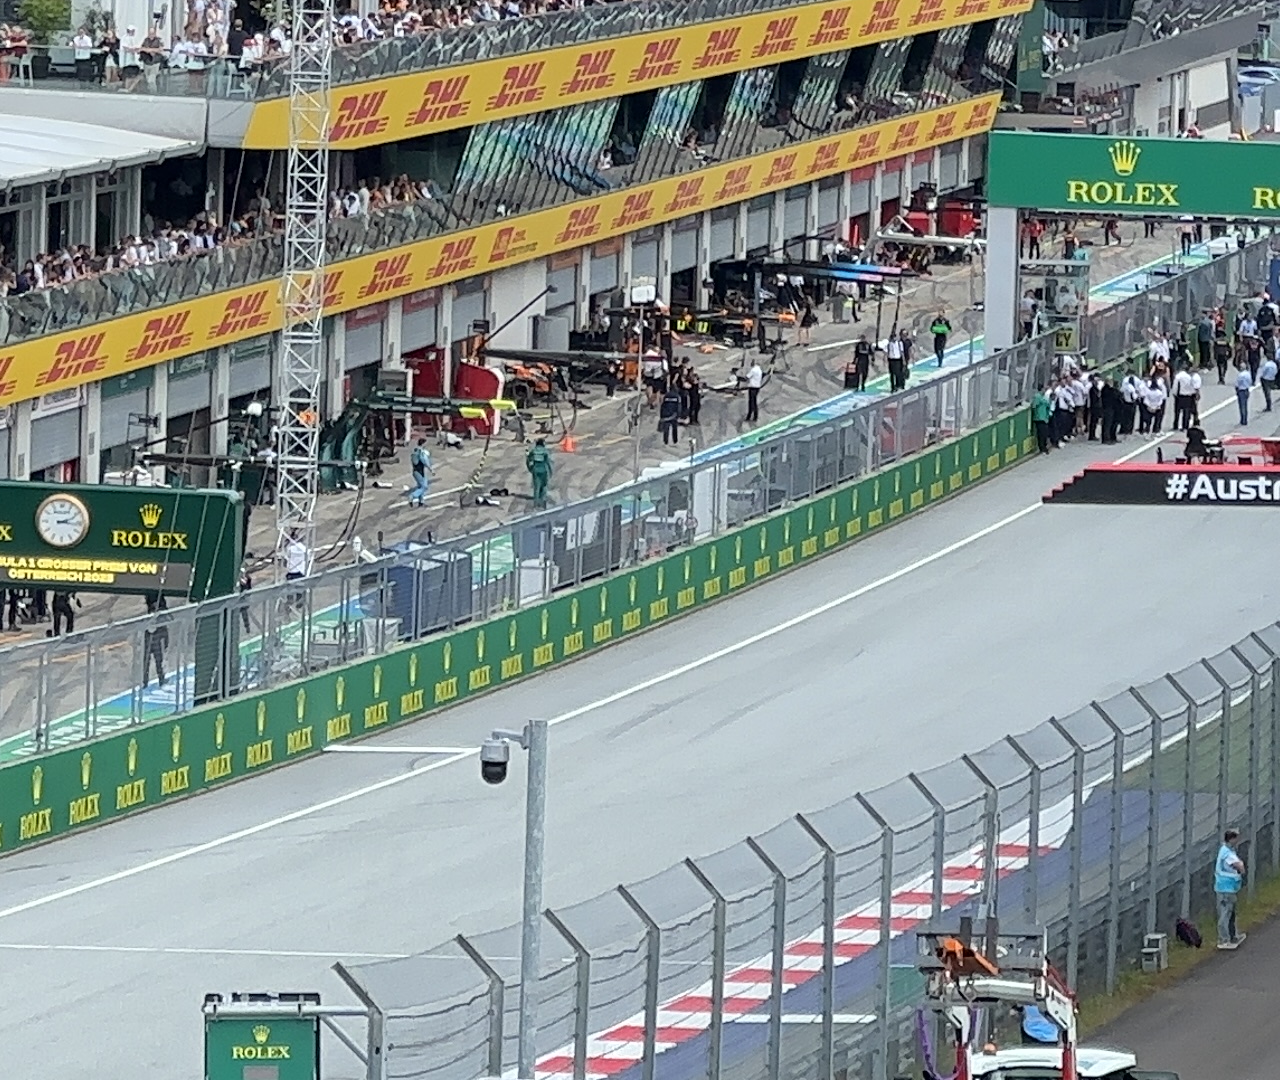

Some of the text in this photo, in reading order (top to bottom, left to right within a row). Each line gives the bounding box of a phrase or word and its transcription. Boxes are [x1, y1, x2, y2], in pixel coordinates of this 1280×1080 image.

[755, 17, 798, 56] DHL
[811, 8, 851, 45] DHL
[631, 38, 681, 80] DHL
[695, 28, 741, 67] DHL
[487, 62, 545, 108] DHL
[563, 50, 615, 93] DHL
[330, 91, 388, 140] DHL
[407, 76, 470, 125] DHL
[1067, 180, 1180, 207] ROLEX
[360, 254, 412, 297] DHL
[429, 238, 476, 278] DHL
[210, 291, 269, 337] DHL
[129, 311, 193, 361] DHL
[37, 333, 106, 386] DHL
[111, 530, 188, 550] ROLEX
[129, 562, 157, 575] VON
[116, 779, 145, 809] ROLEX
[160, 765, 190, 795] ROLEX
[19, 808, 52, 840] ROLEX
[69, 793, 100, 825] ROLEX
[231, 1046, 291, 1060] ROLEX
